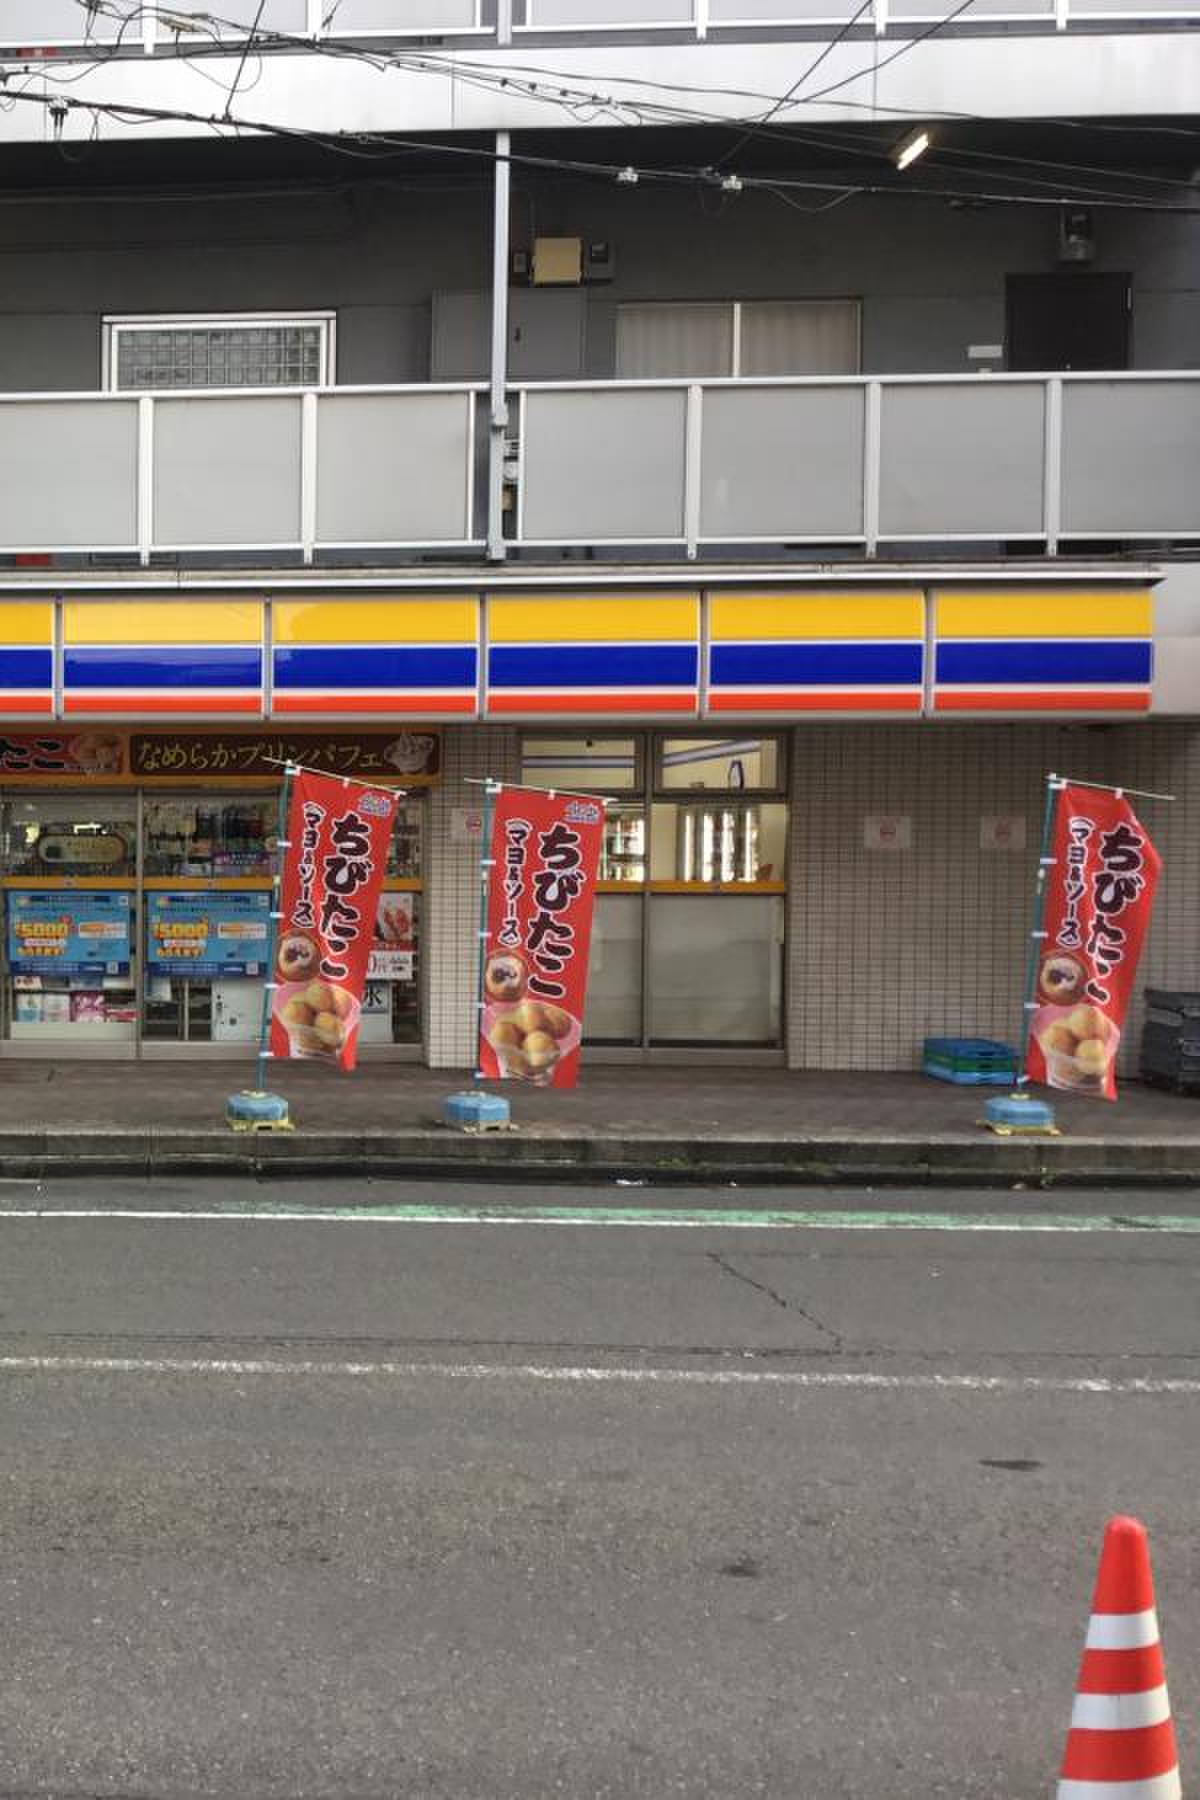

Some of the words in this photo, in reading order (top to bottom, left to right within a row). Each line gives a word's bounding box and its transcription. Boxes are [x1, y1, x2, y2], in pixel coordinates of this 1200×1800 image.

[138, 741, 383, 770] なめらかプリンパフェ
[320, 811, 374, 980] ちびたこ
[527, 822, 586, 998] ちびたこ
[1086, 823, 1145, 1003] ちびたこ
